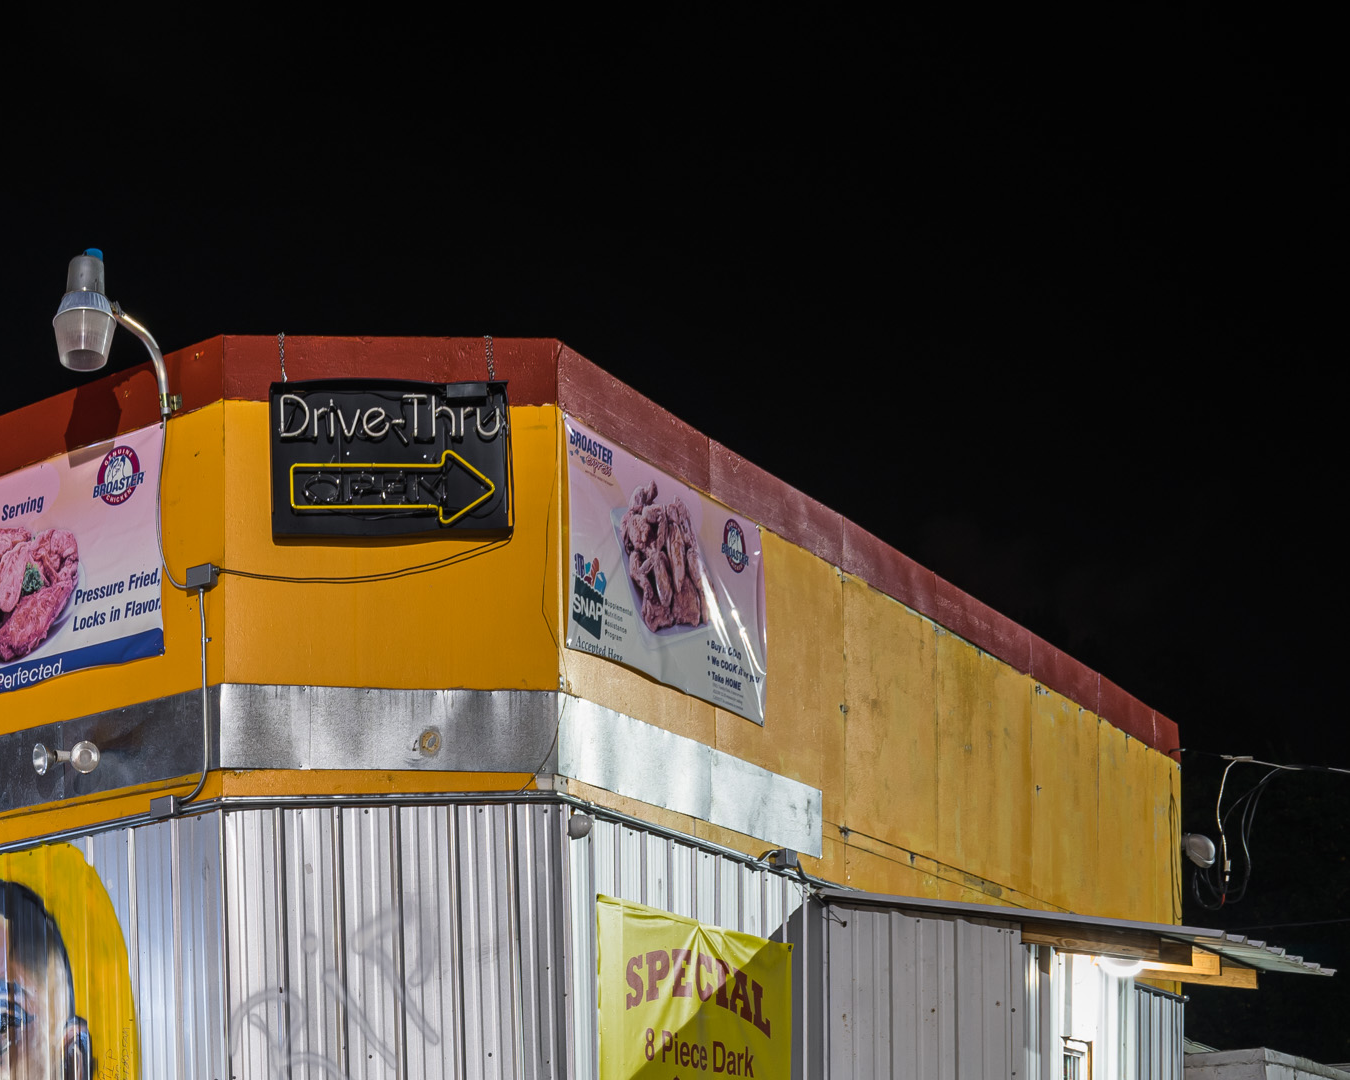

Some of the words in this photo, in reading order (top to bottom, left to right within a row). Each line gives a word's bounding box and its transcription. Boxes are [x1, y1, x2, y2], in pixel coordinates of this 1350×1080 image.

[280, 394, 500, 437] Drive-Thru
[570, 428, 613, 466] BROASTER
[93, 472, 145, 498] BROASTER
[106, 488, 132, 503] CHICKEN
[2, 495, 45, 523] Serving
[74, 578, 124, 606] Pressure
[128, 568, 161, 592] Fried,
[72, 607, 107, 632] Locks
[110, 604, 120, 622] in
[124, 597, 162, 620] Flavor.
[573, 593, 603, 622] SNAP
[576, 636, 607, 657] Accepted
[721, 660, 738, 673] COOK
[725, 677, 742, 691] HOME
[626, 949, 771, 1039] SPECIAL
[645, 1028, 655, 1061] 8
[662, 1030, 708, 1071] Piece
[712, 1041, 754, 1078] Dark
